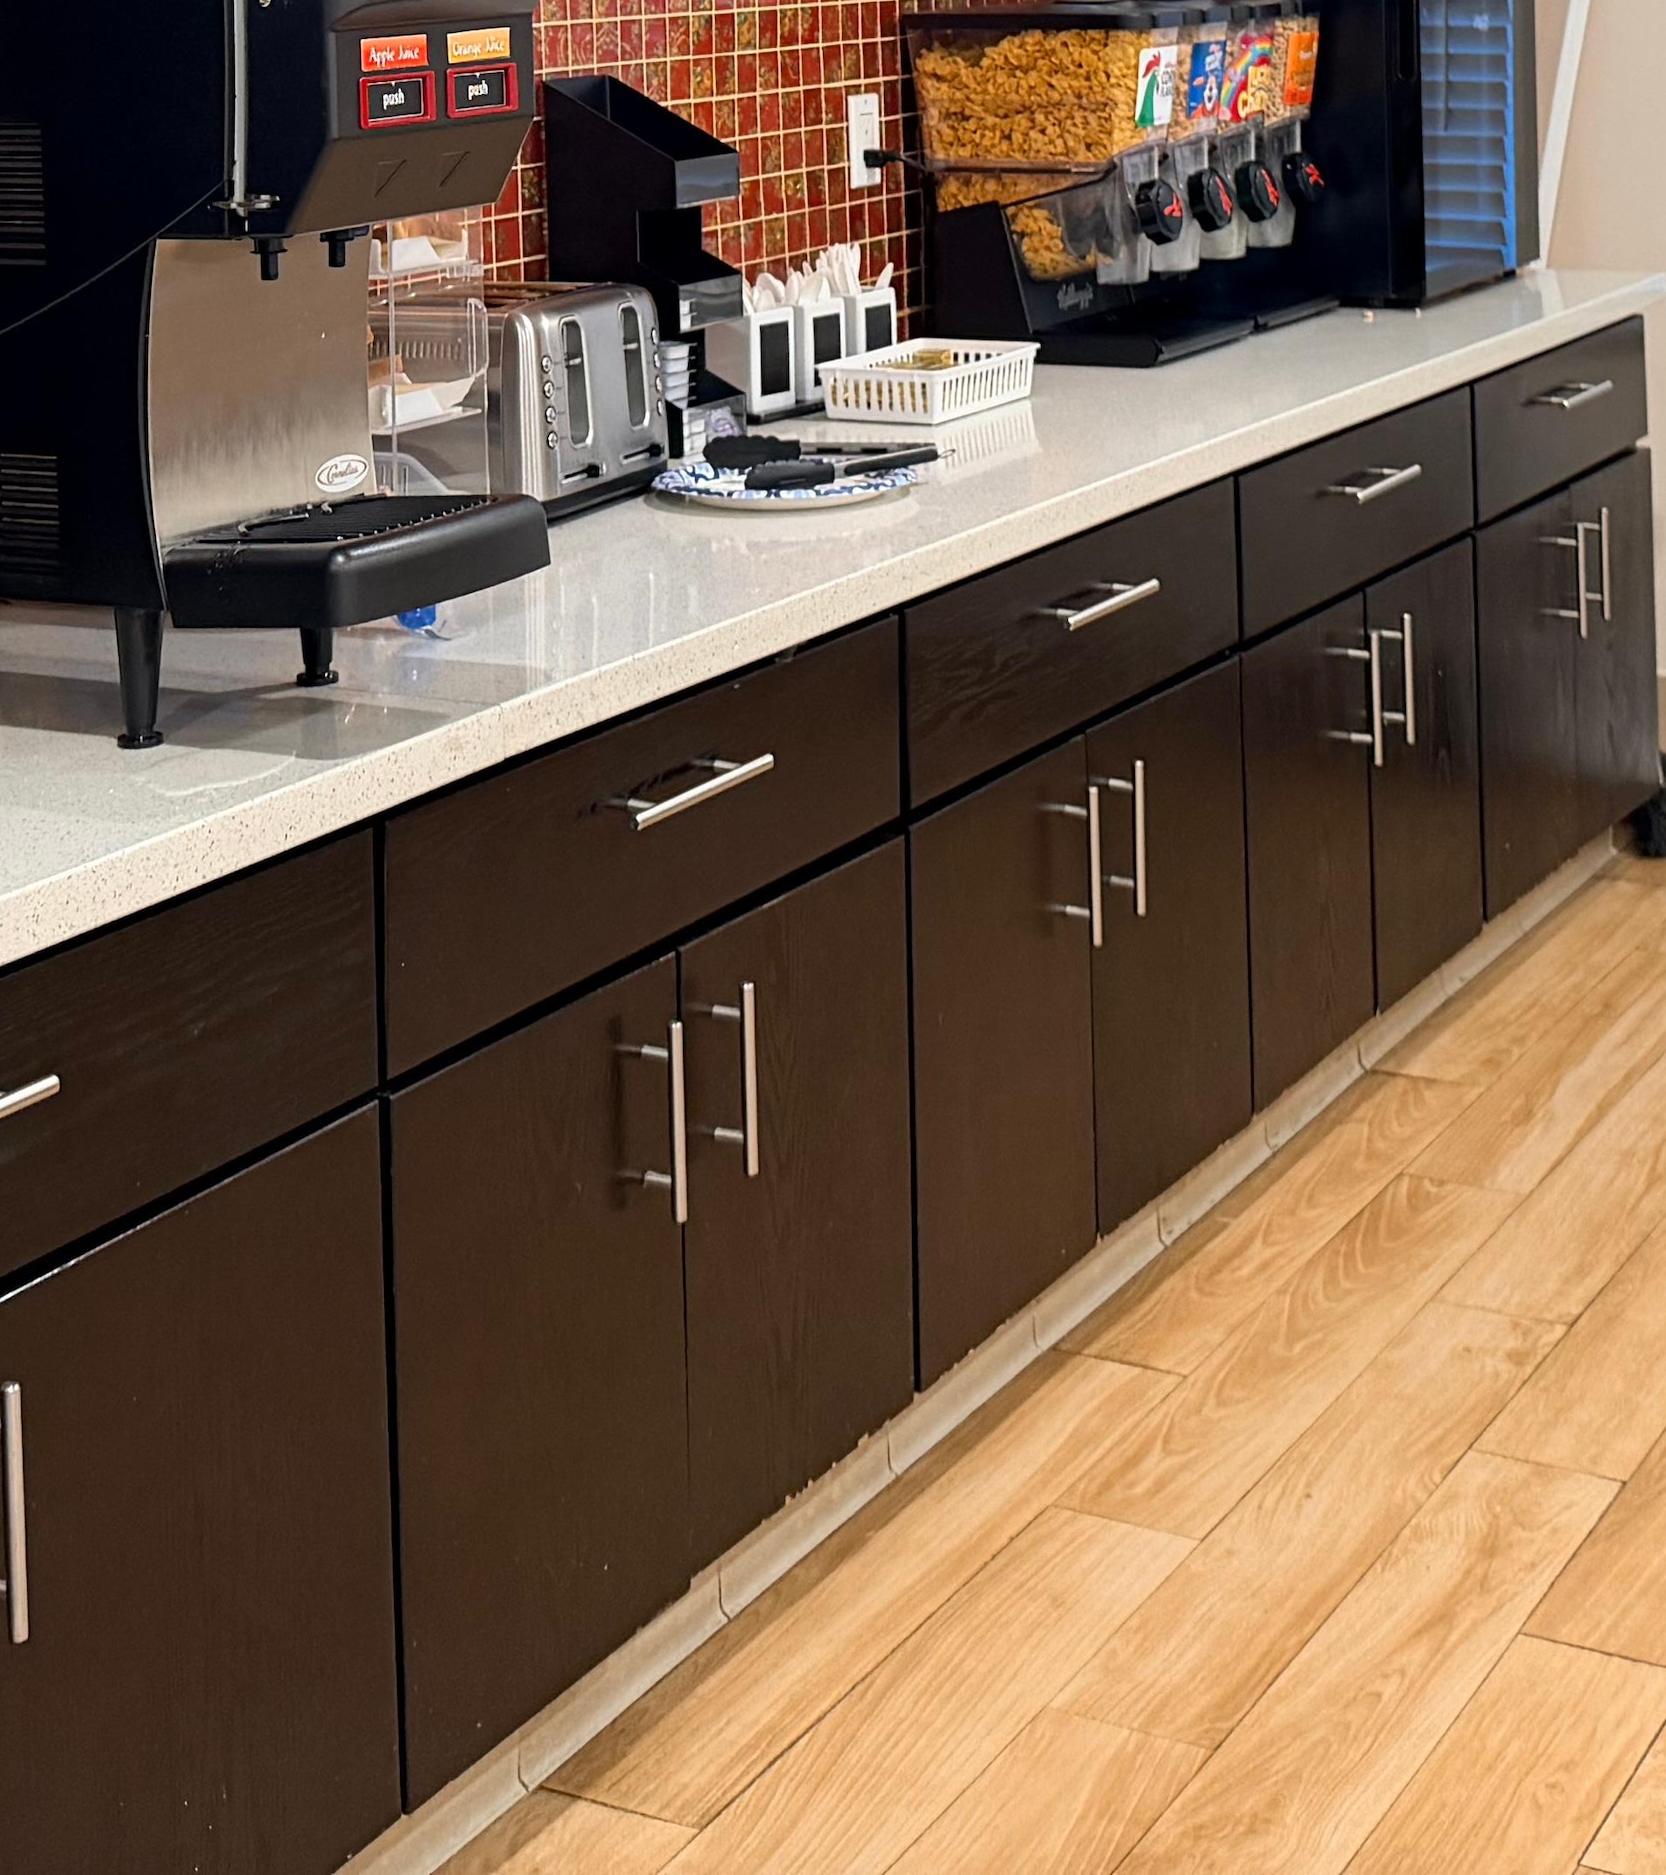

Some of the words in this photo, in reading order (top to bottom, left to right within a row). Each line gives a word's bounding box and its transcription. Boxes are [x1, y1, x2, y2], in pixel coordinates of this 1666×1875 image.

[369, 46, 394, 67] Apple
[398, 45, 420, 61] Juice
[452, 41, 482, 58] Orange
[486, 36, 505, 53] Juice
[383, 88, 405, 110] push
[468, 79, 489, 101] push
